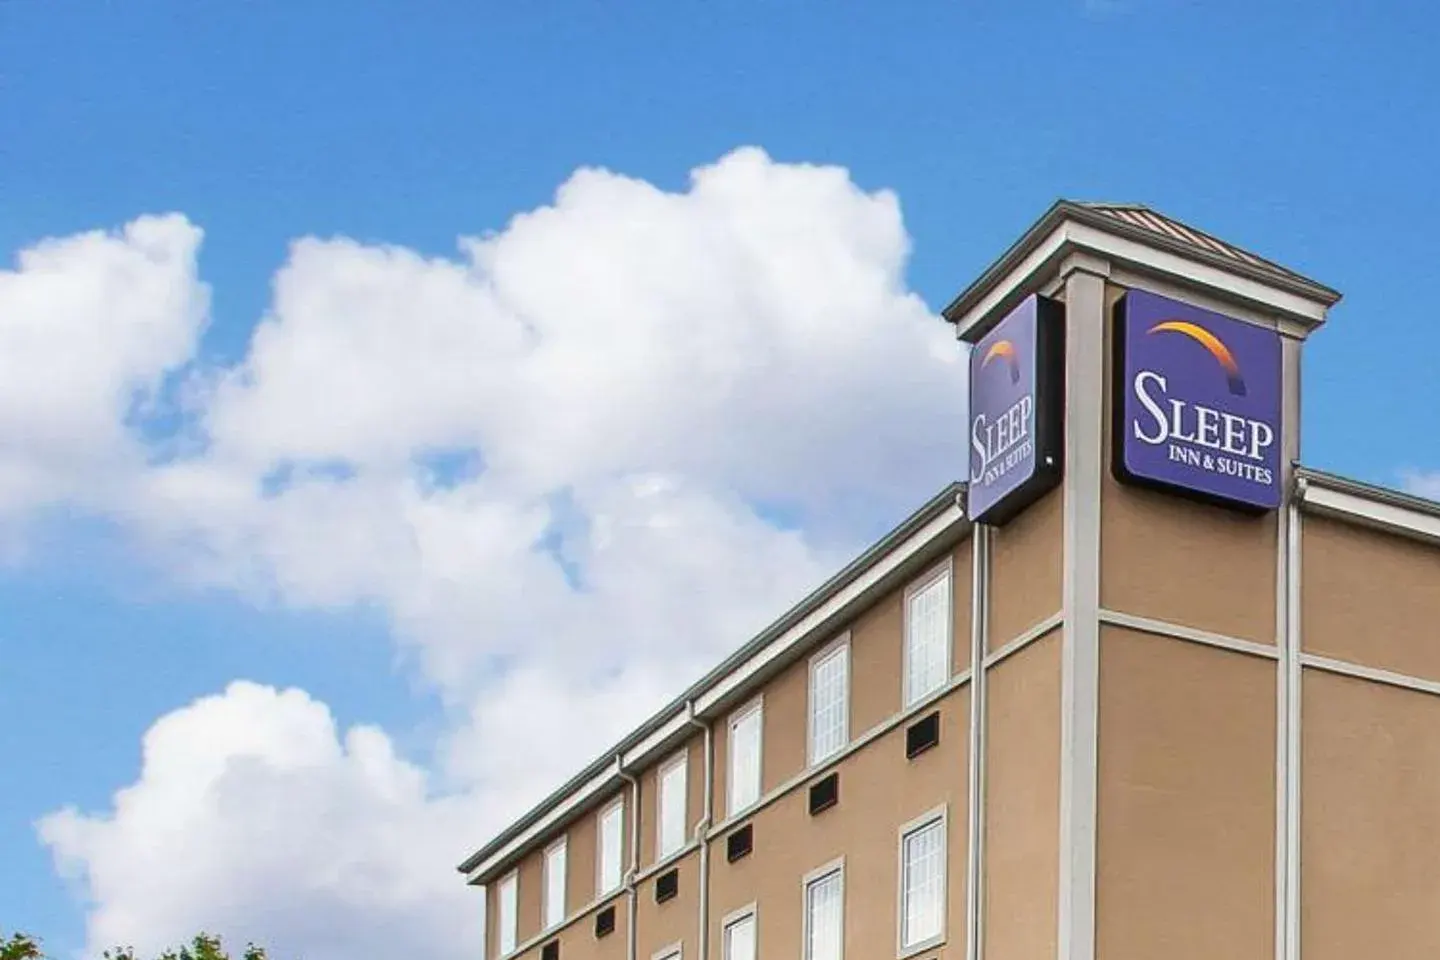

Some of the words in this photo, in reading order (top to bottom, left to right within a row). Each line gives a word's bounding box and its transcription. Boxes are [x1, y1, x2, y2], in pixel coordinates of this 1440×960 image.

[972, 396, 1031, 483] SLEEP
[1134, 371, 1273, 460] SLEEP
[1169, 445, 1201, 467] INN
[1203, 455, 1215, 471] &
[1217, 457, 1272, 485] SUITES
